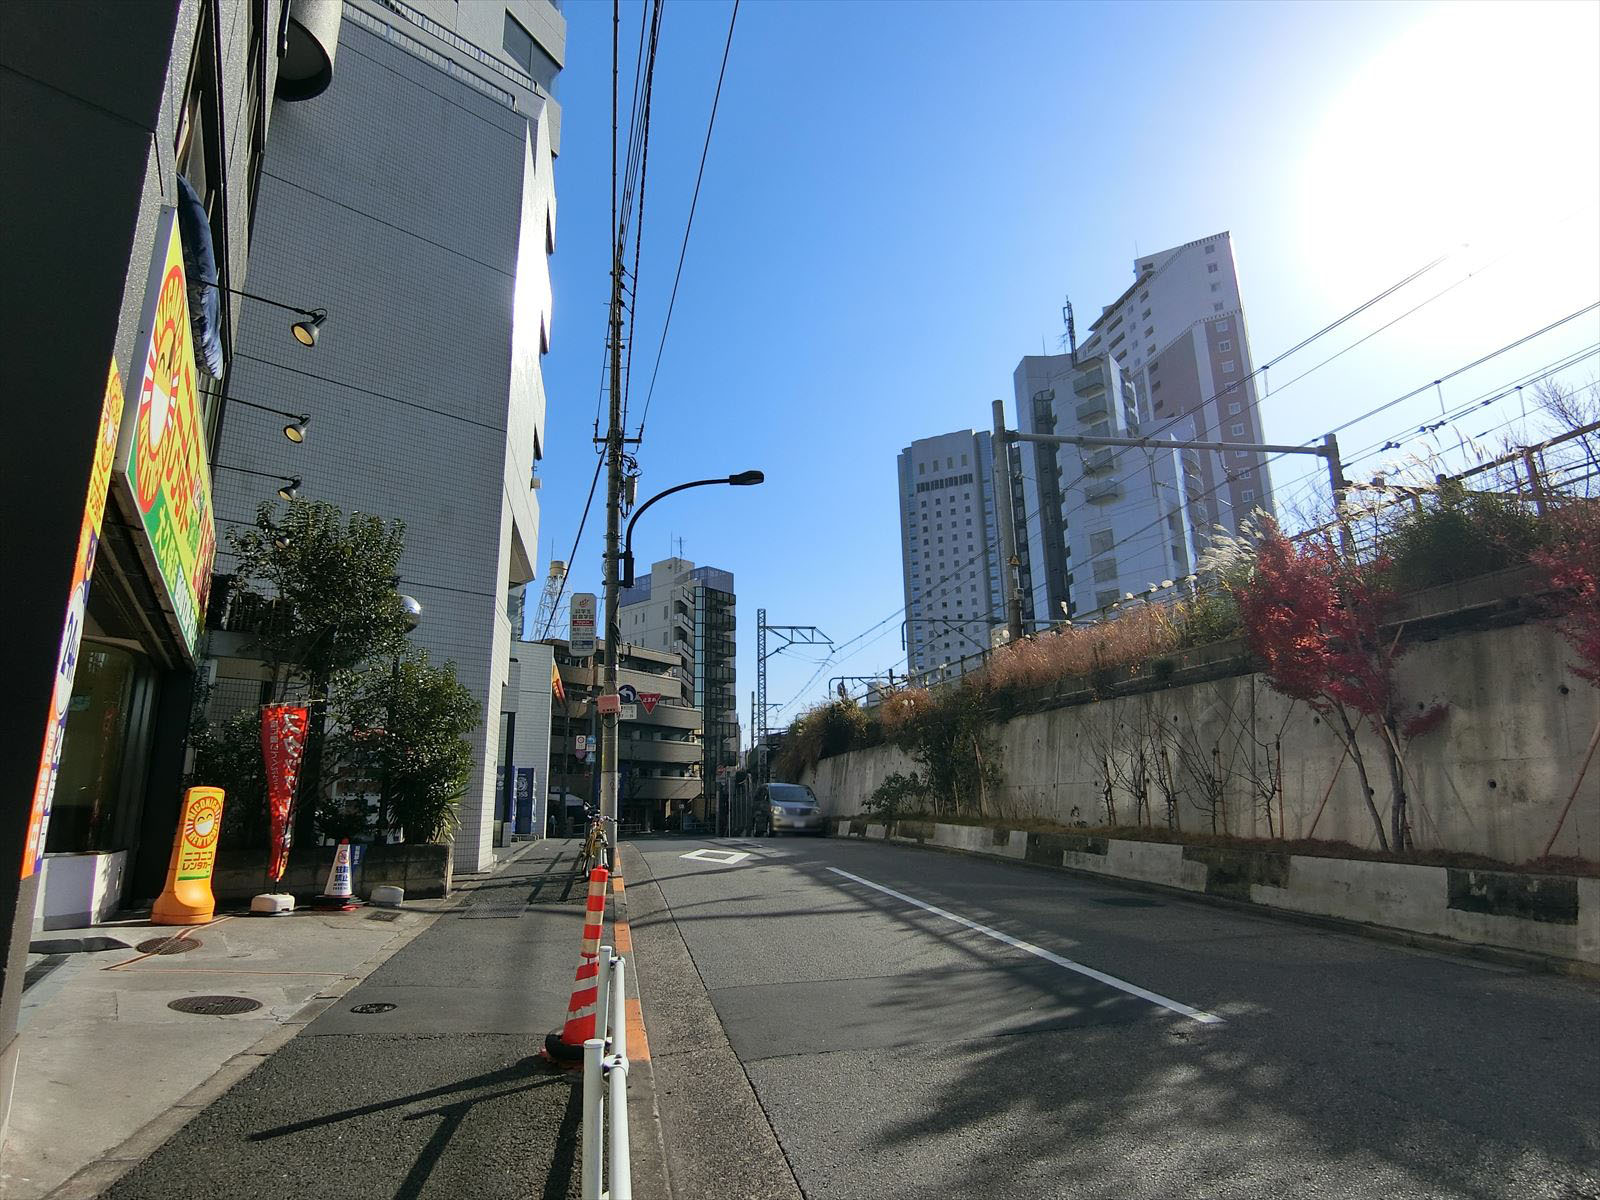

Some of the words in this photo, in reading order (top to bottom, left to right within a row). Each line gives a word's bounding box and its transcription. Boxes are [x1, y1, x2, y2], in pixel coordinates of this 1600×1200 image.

[177, 360, 200, 498] ニコニコ
[166, 424, 189, 534] レンタカー
[182, 861, 211, 871] レンタカー
[183, 851, 213, 862] ニコニコ
